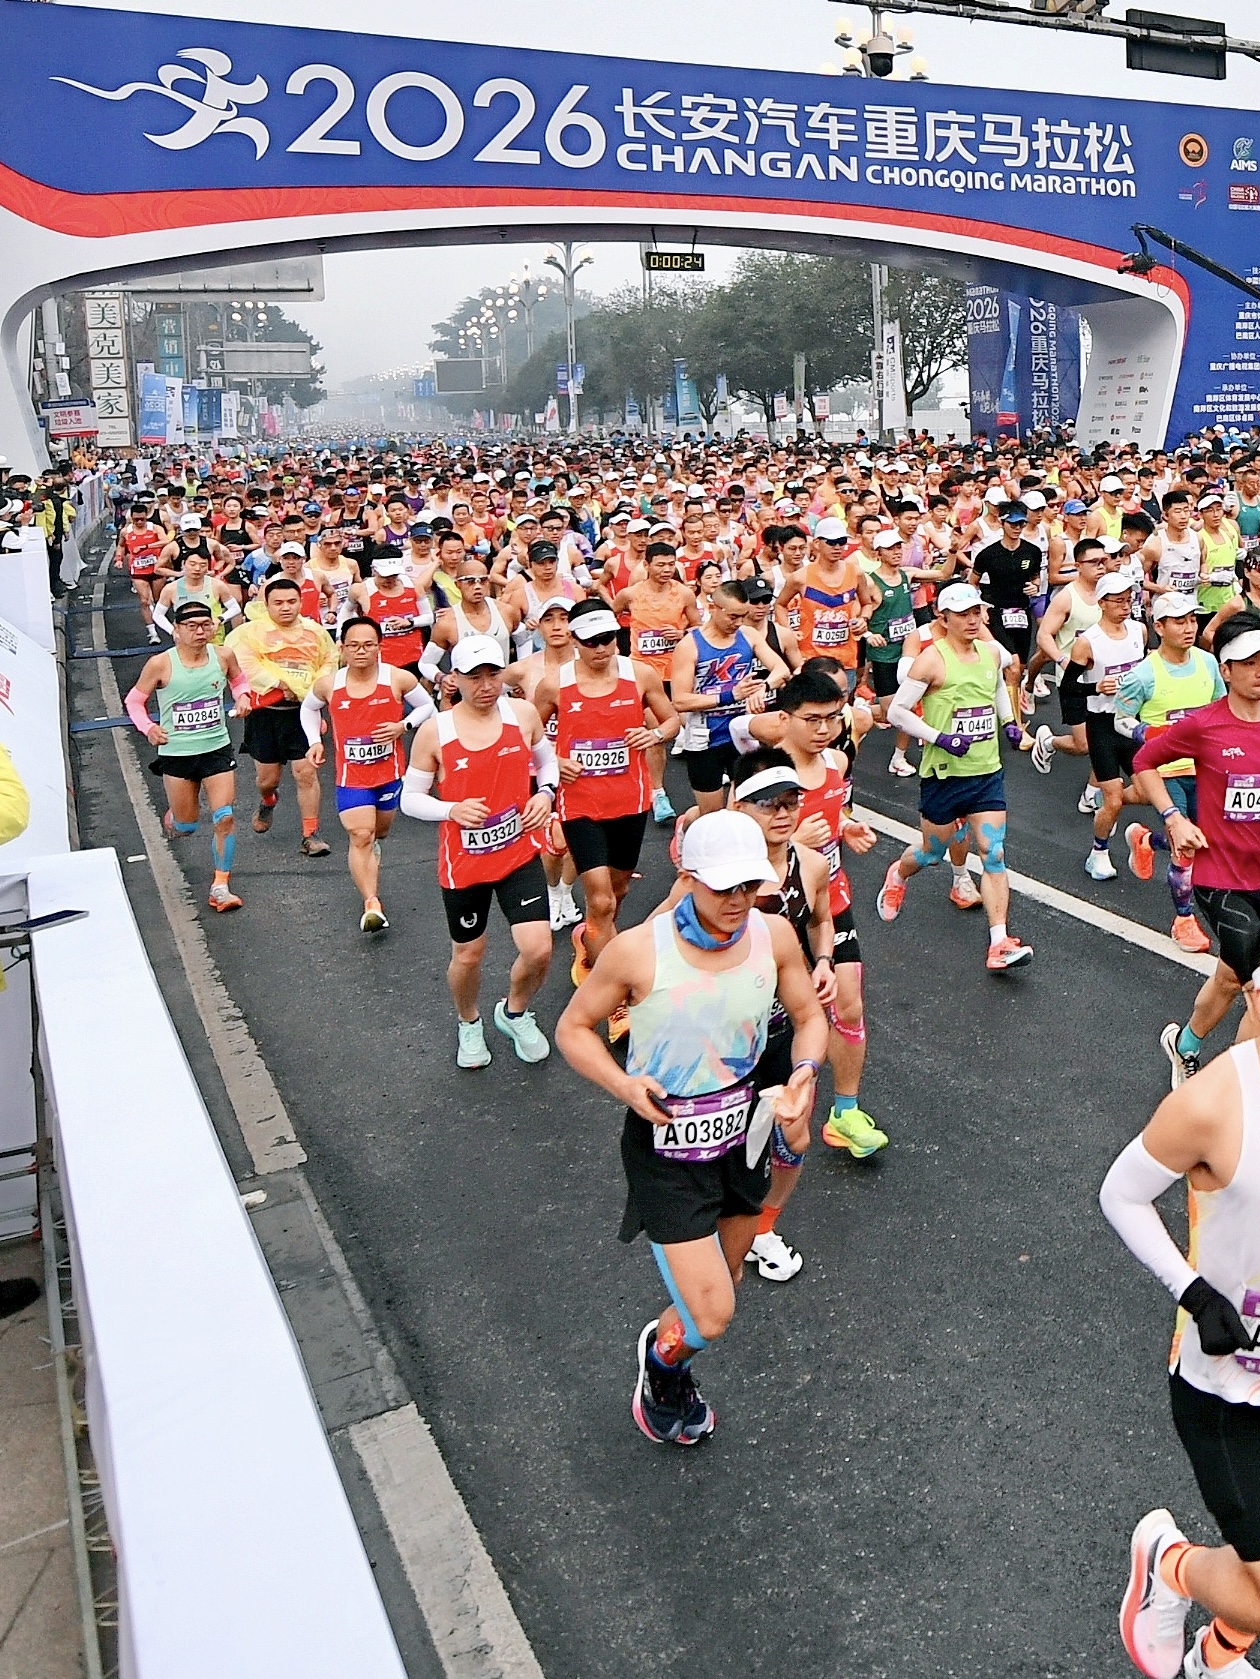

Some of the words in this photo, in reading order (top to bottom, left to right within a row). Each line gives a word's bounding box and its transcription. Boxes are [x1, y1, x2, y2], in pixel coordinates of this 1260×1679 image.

[286, 64, 607, 169] 2026
[614, 88, 1135, 174] 长安汽车重庆马拉松
[617, 142, 859, 182] CHANGAN
[1230, 159, 1258, 172] AIMS
[651, 255, 702, 269] 0:00:24
[966, 296, 1000, 320] 2026
[89, 302, 125, 414] 美克美家
